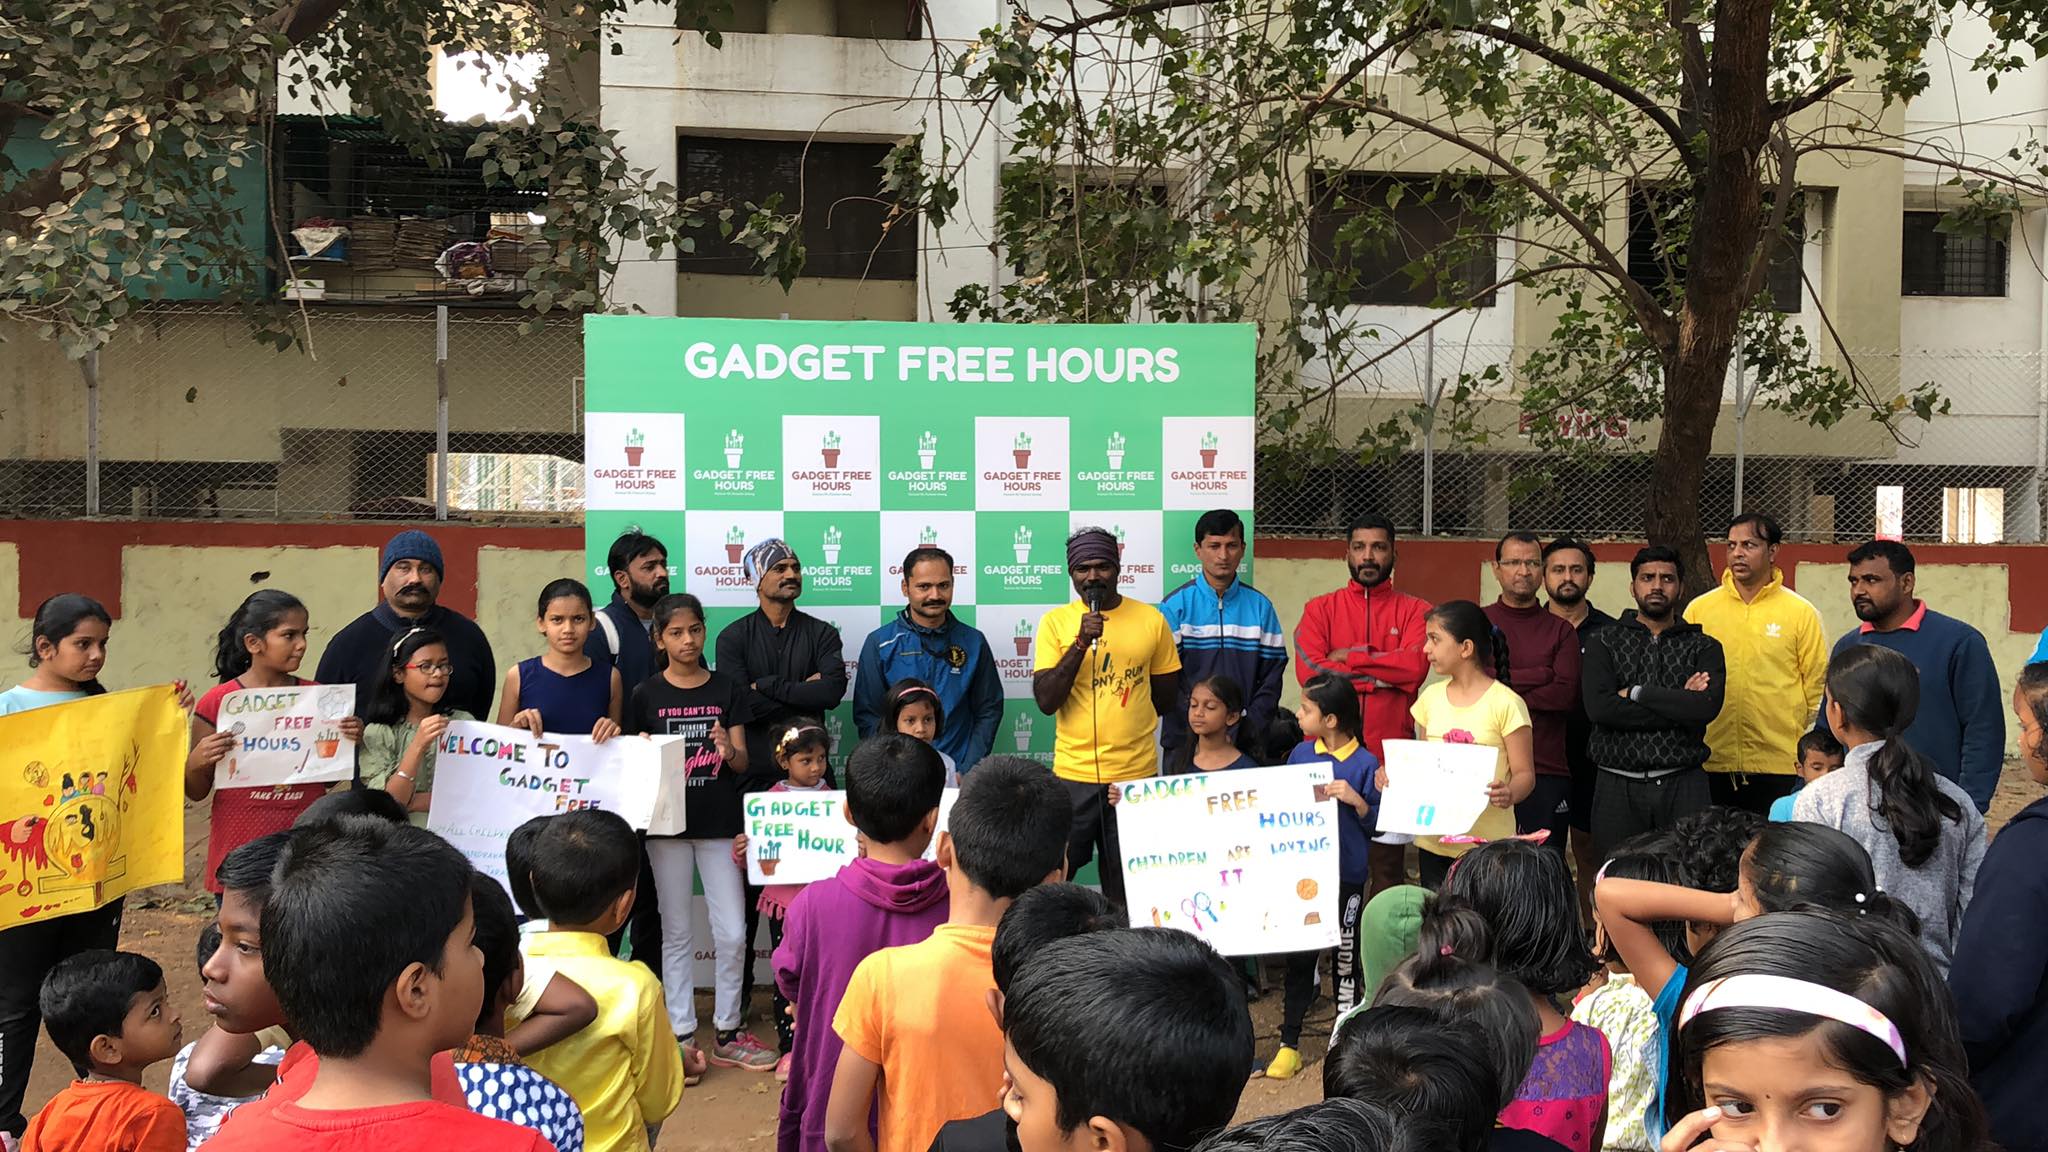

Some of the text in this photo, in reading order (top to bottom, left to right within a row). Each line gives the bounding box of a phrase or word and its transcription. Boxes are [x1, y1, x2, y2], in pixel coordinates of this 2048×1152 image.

[684, 341, 1180, 383] GADGET FREE HOURS
[594, 470, 676, 479] GADGET FREE
[693, 470, 776, 480] GADGET FREE
[792, 471, 872, 480] GADGET FREE
[888, 472, 968, 480] GADGET FREE
[984, 472, 1062, 481] GADGET FREE
[1078, 472, 1155, 481] GADGET FREE
[1170, 471, 1248, 480] GADGET FREE
[615, 480, 656, 490] HOURS
[714, 481, 755, 490] HOURS
[812, 482, 851, 491] HOURS
[908, 482, 947, 491] HOURS
[1004, 482, 1042, 491] HOURS
[1097, 482, 1135, 491] HOURS
[1190, 481, 1228, 490] HOURS
[694, 566, 744, 576] GADGET
[800, 566, 872, 576] ADGET FREE
[984, 565, 1062, 575] GADGET FREE
[1127, 564, 1155, 574] FREE
[813, 577, 852, 586] HOURS
[1004, 576, 1042, 585] HOURS
[994, 659, 1032, 668] ADGET
[226, 693, 300, 716] GADGET
[658, 708, 666, 718] IF
[668, 708, 682, 716] YOU
[683, 706, 704, 716] CAN'T
[274, 716, 314, 730] FREE
[243, 736, 301, 752] HOURS
[439, 730, 527, 764] WELCOME
[499, 767, 590, 794] GADGET
[250, 791, 272, 800] TAKE
[274, 791, 282, 800] IT
[1124, 776, 1259, 816] GADGET FREE
[555, 795, 602, 812] FREE
[746, 798, 836, 816] GADGET
[1259, 811, 1325, 828] HOURS
[752, 820, 845, 854] FREE HOUR
[1128, 837, 1330, 873] CHILDREN ARE LOVING
[1220, 868, 1243, 886] IT
